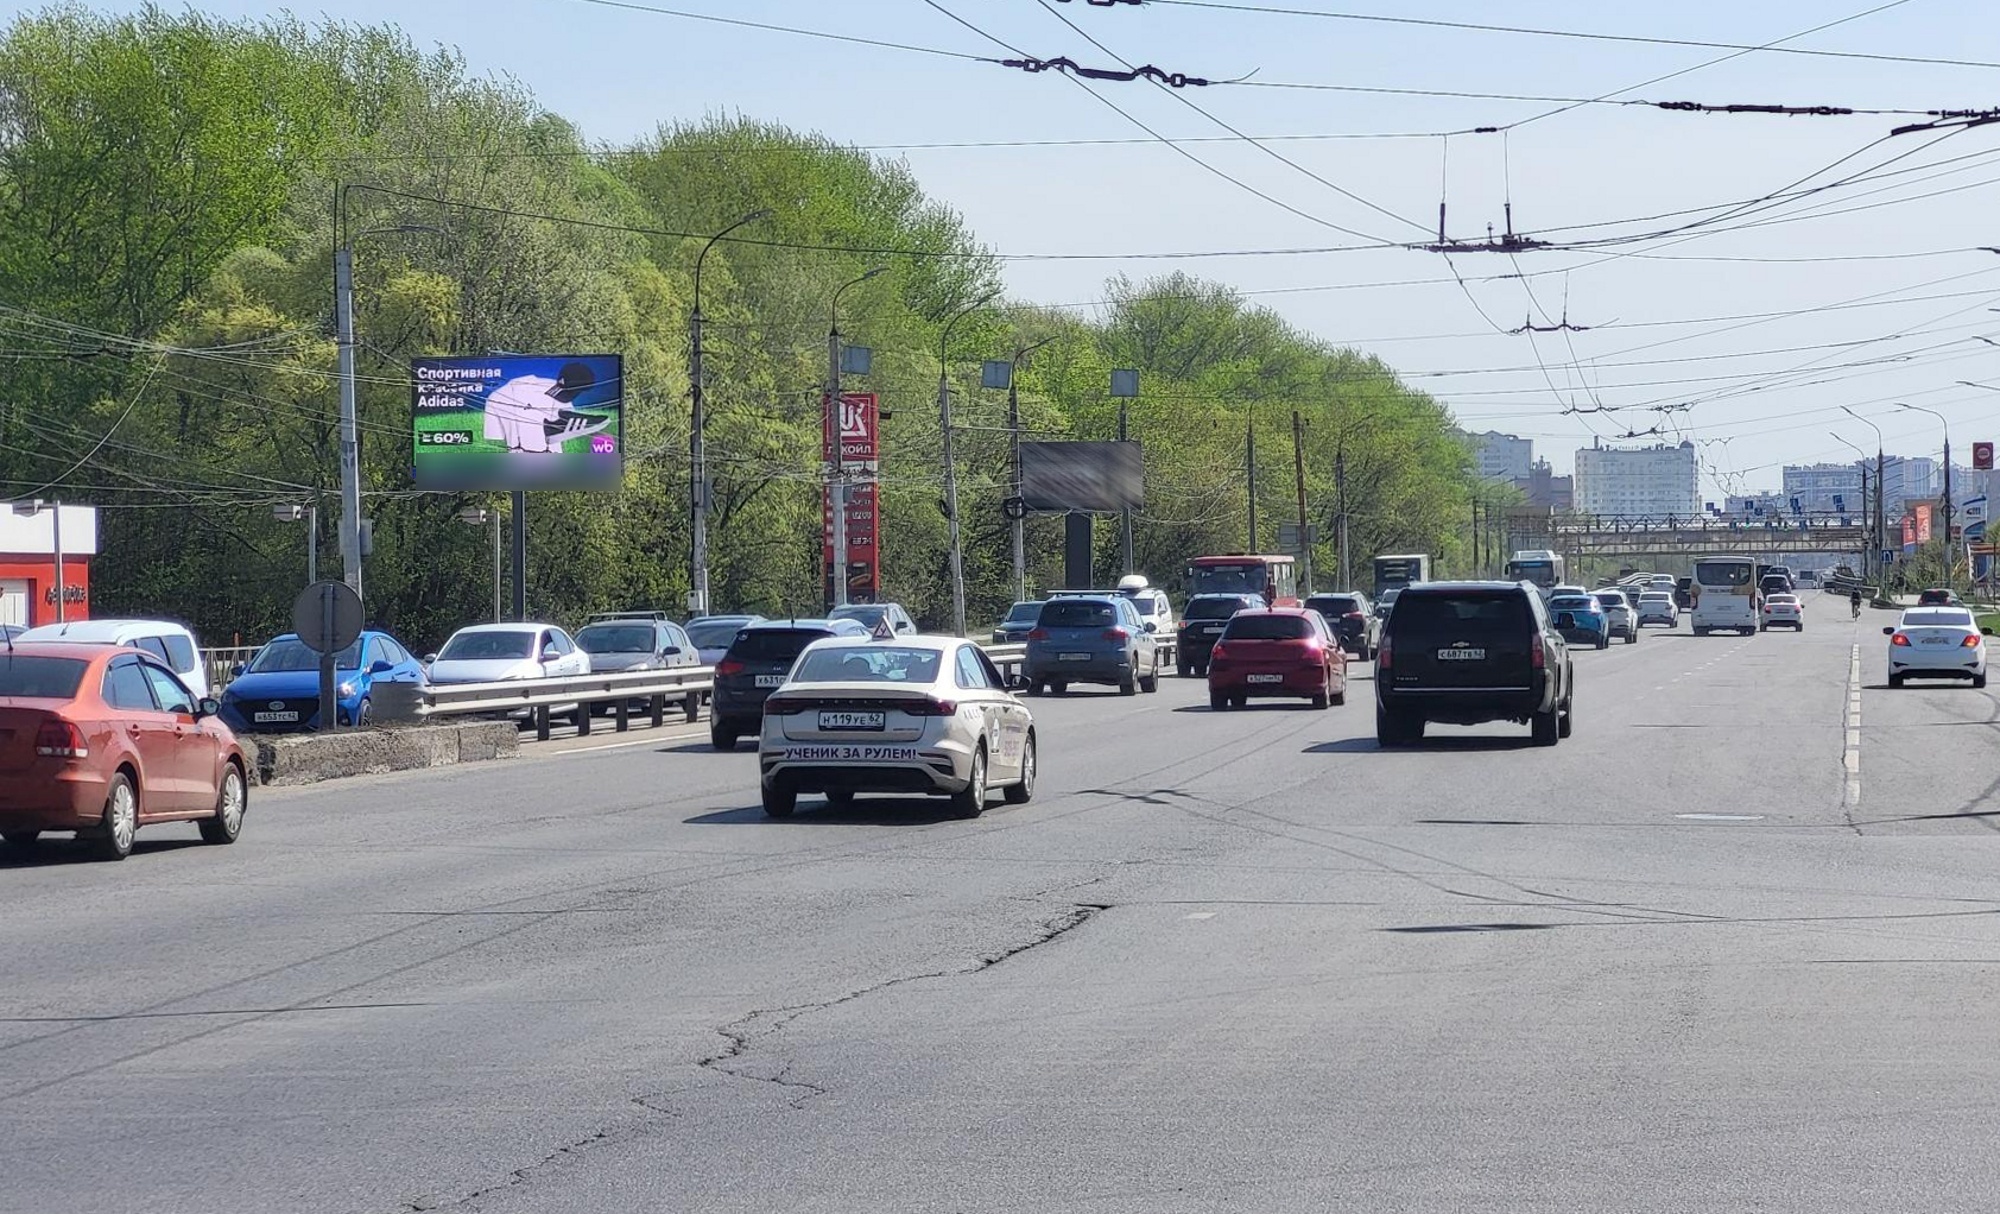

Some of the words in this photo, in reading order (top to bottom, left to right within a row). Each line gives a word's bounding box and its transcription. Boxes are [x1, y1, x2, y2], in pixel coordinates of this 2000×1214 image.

[417, 367, 502, 380] Спортивная
[417, 395, 465, 407] Adidas
[592, 440, 614, 453] wb
[785, 748, 839, 759] УЧЕНИК
[844, 748, 861, 759] ЗА
[865, 748, 917, 759] РУЛЕМ!
